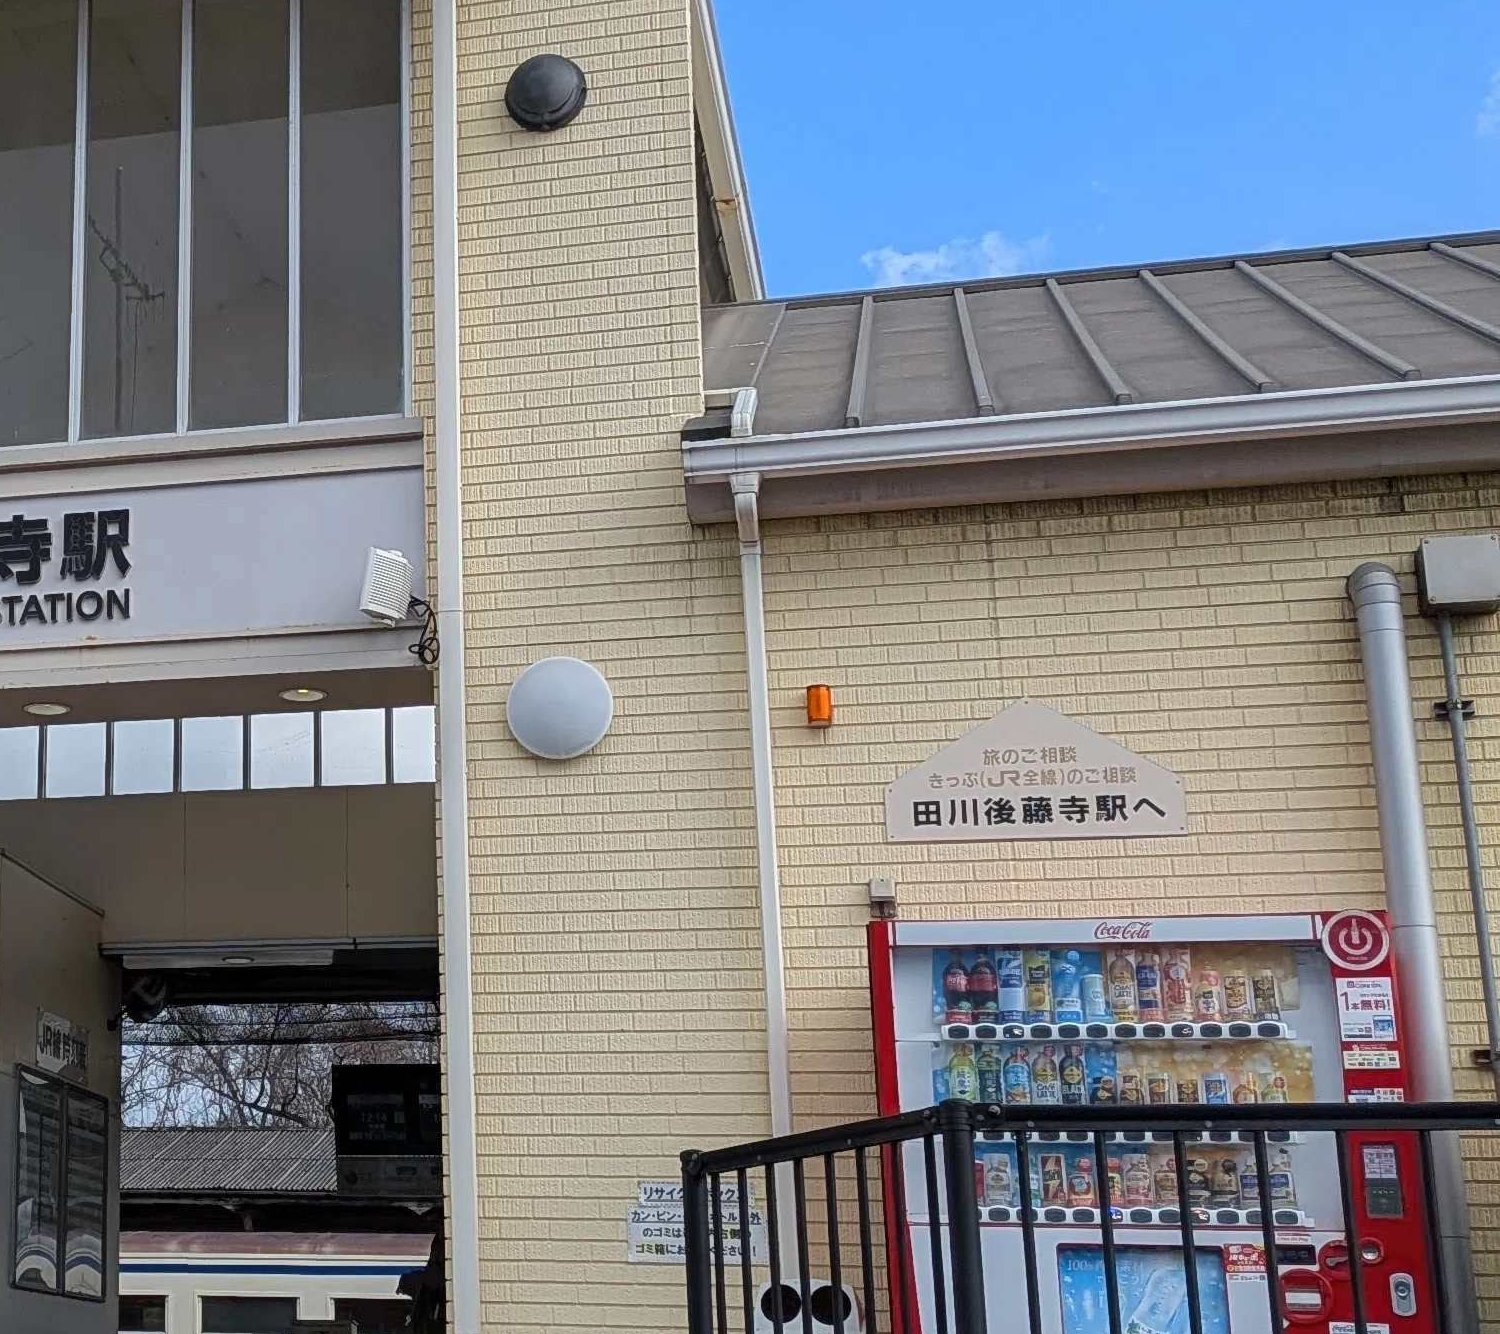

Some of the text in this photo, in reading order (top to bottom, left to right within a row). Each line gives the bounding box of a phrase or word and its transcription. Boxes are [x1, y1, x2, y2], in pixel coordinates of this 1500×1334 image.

[982, 746, 1077, 766] 旅のご相談
[928, 766, 1137, 790] きっぷ(JR全線)のご相談
[912, 794, 1167, 827] 田川後藤寺駅へ
[1093, 921, 1153, 940] Coca-Cola
